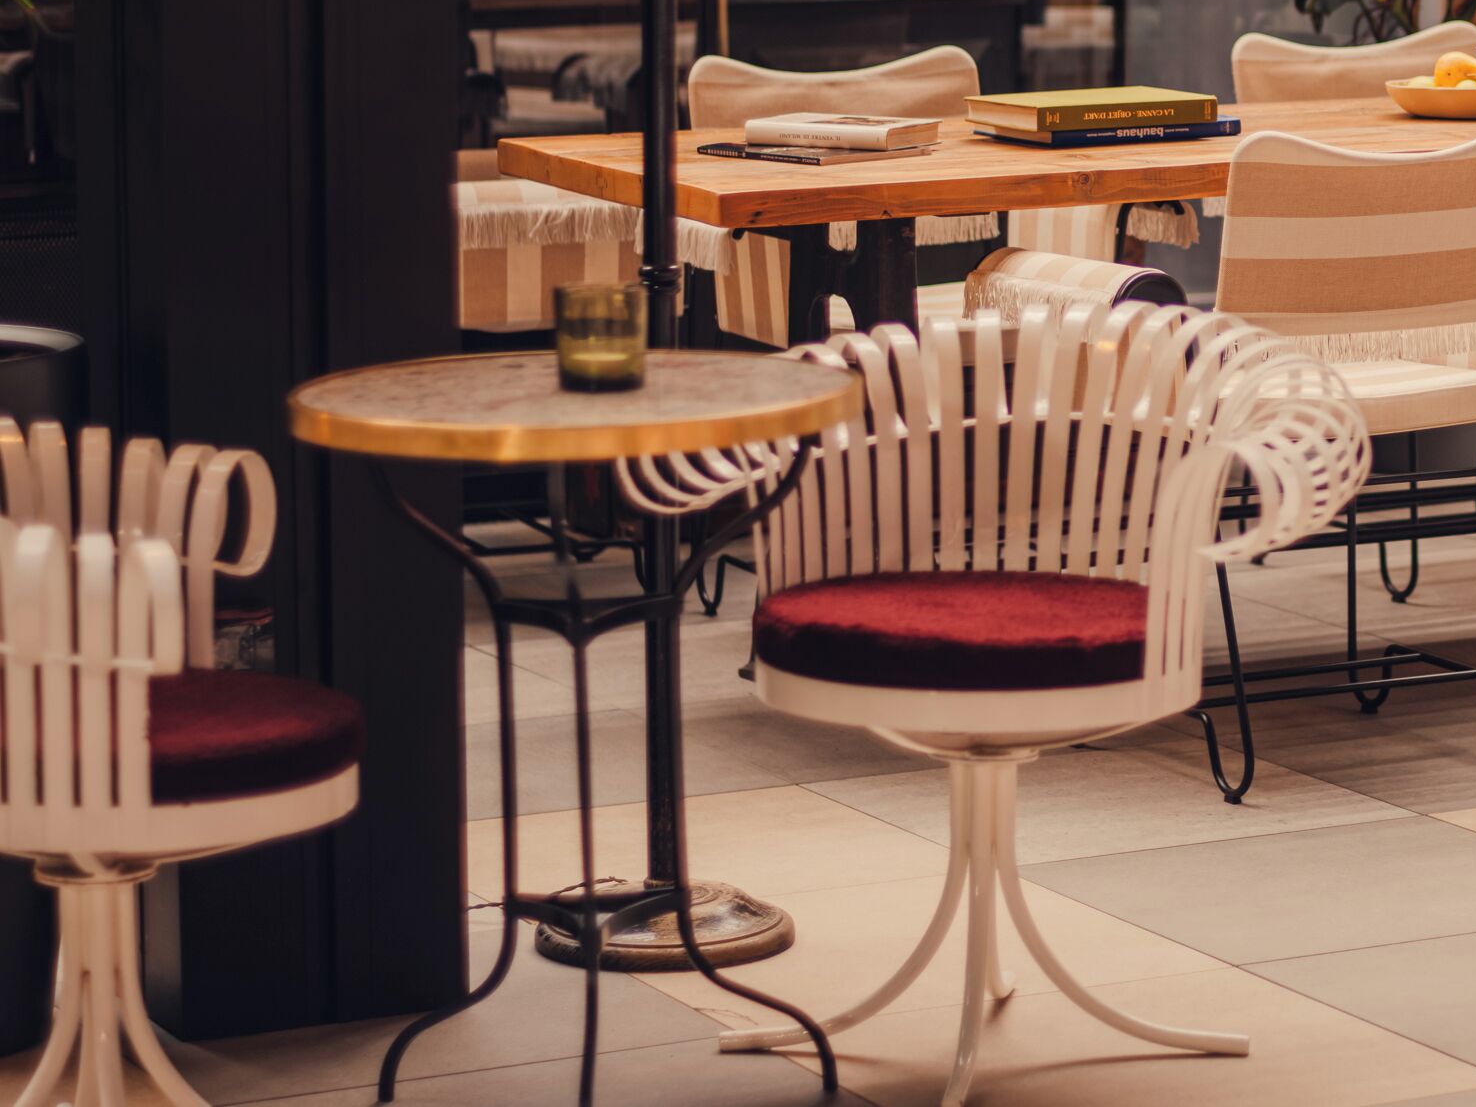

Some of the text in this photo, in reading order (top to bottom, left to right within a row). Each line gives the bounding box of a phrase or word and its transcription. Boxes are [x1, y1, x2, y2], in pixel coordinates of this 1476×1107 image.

[1083, 111, 1107, 121] D'ART
[1107, 109, 1132, 120] OBJET
[1136, 109, 1163, 118] CANNE
[1163, 108, 1175, 117] LA
[1116, 127, 1165, 138] bauhaus
